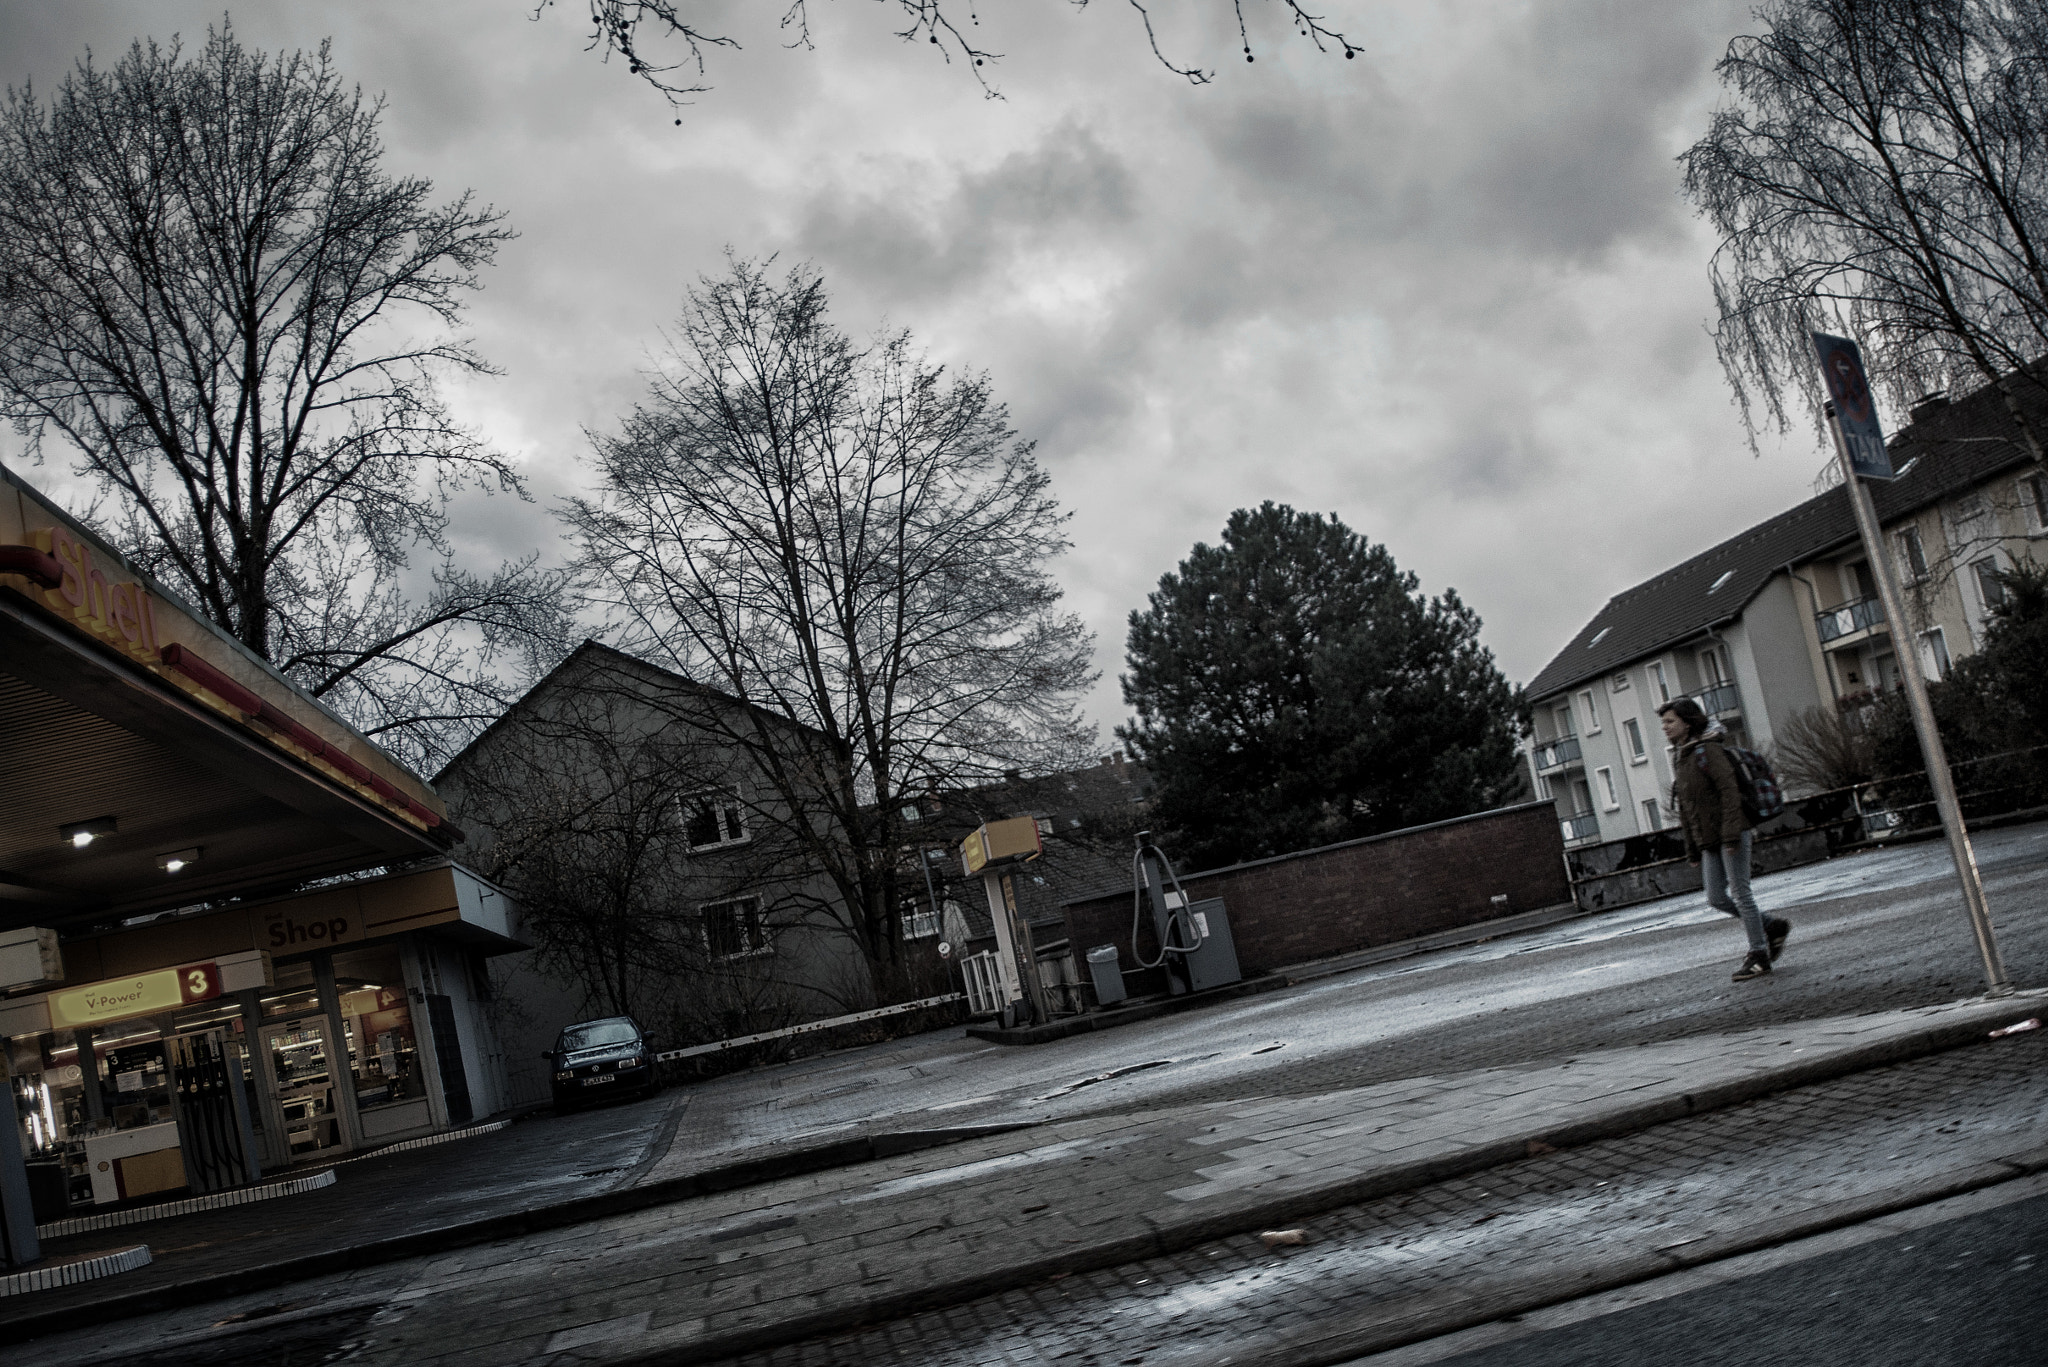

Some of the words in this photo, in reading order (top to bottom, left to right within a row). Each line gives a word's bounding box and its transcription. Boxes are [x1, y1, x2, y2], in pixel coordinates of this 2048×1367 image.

[1846, 432, 1888, 466] TAXI
[50, 526, 162, 660] Shell
[268, 917, 348, 947] Shop
[187, 969, 209, 995] 3
[86, 991, 142, 1009] V-Power
[110, 1055, 119, 1066] 3
